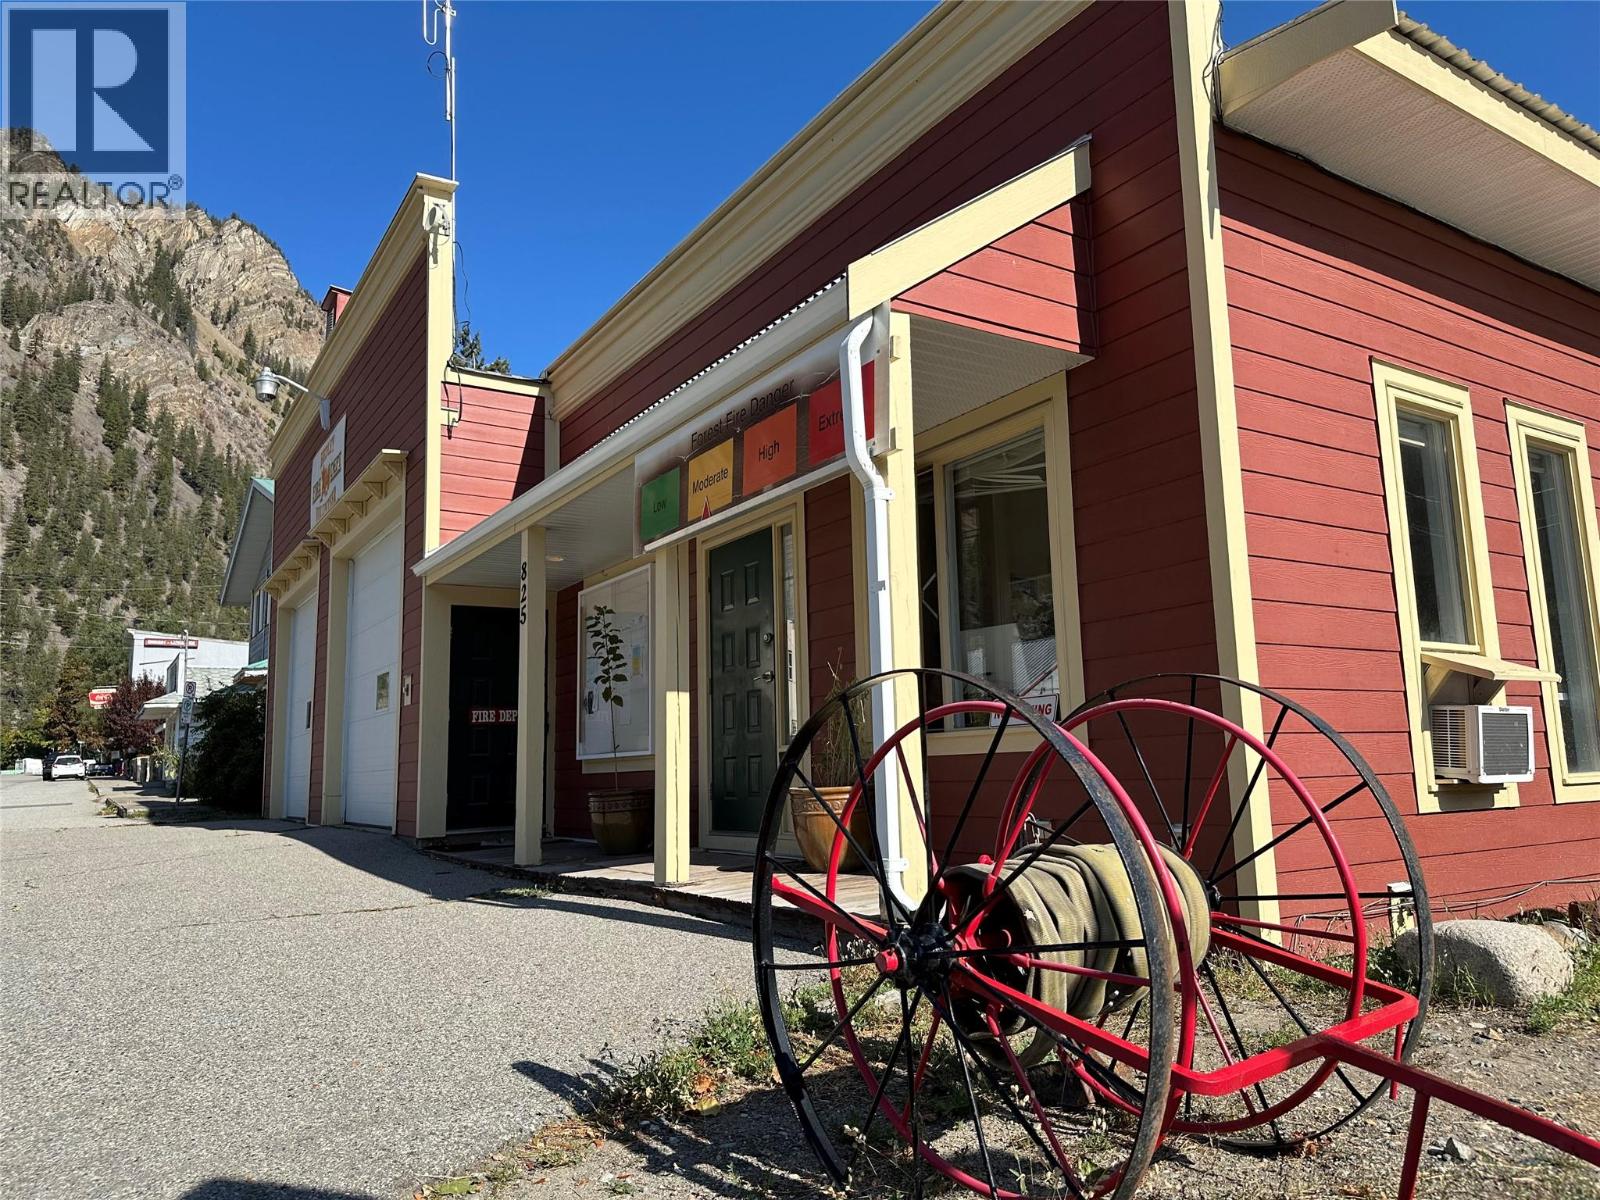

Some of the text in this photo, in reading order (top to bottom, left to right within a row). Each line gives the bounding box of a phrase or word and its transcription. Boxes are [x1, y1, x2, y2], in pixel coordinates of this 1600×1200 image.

[691, 379, 795, 450] Forest Fire Danger
[818, 411, 844, 432] Extr
[758, 440, 780, 462] High
[692, 467, 729, 495] Moderate
[653, 499, 668, 513] Low
[471, 709, 518, 723] FIRE DEP
